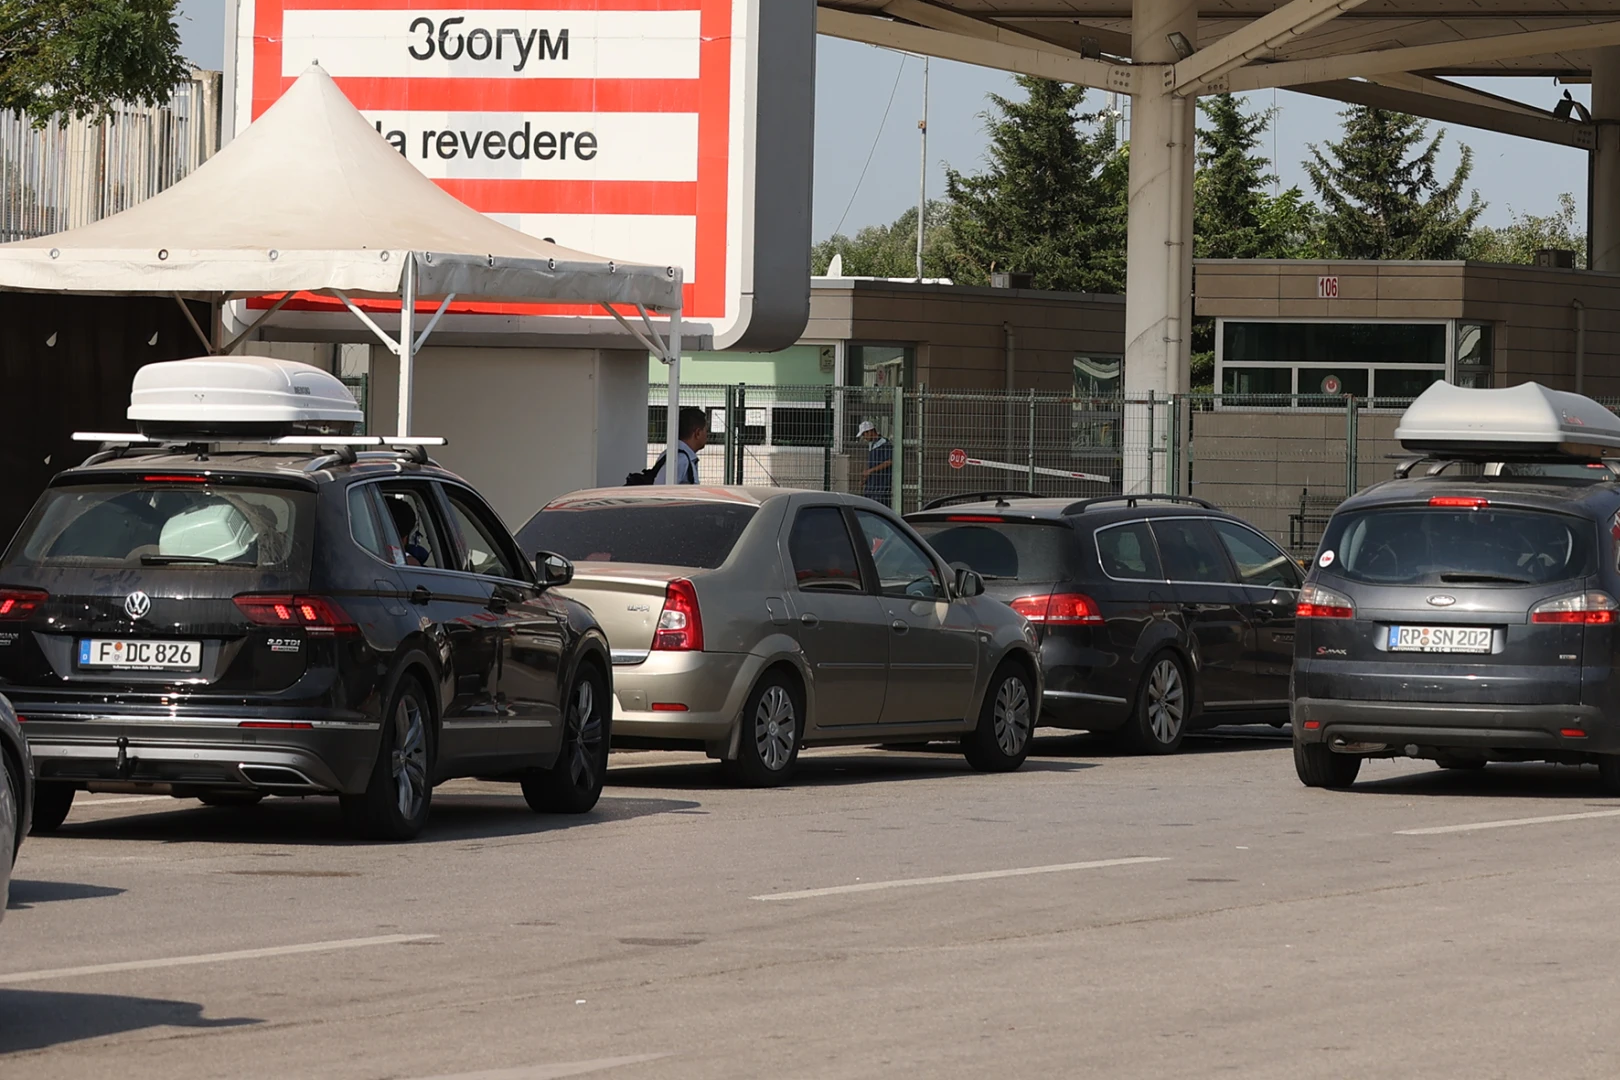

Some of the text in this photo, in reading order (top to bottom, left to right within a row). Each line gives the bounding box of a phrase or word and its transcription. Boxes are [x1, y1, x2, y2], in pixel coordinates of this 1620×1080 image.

[408, 16, 570, 72] Збогум
[422, 121, 598, 161] revedere
[1319, 277, 1337, 297] 106
[1399, 628, 1489, 647] RP SN 202
[100, 642, 192, 664] F DC 826
